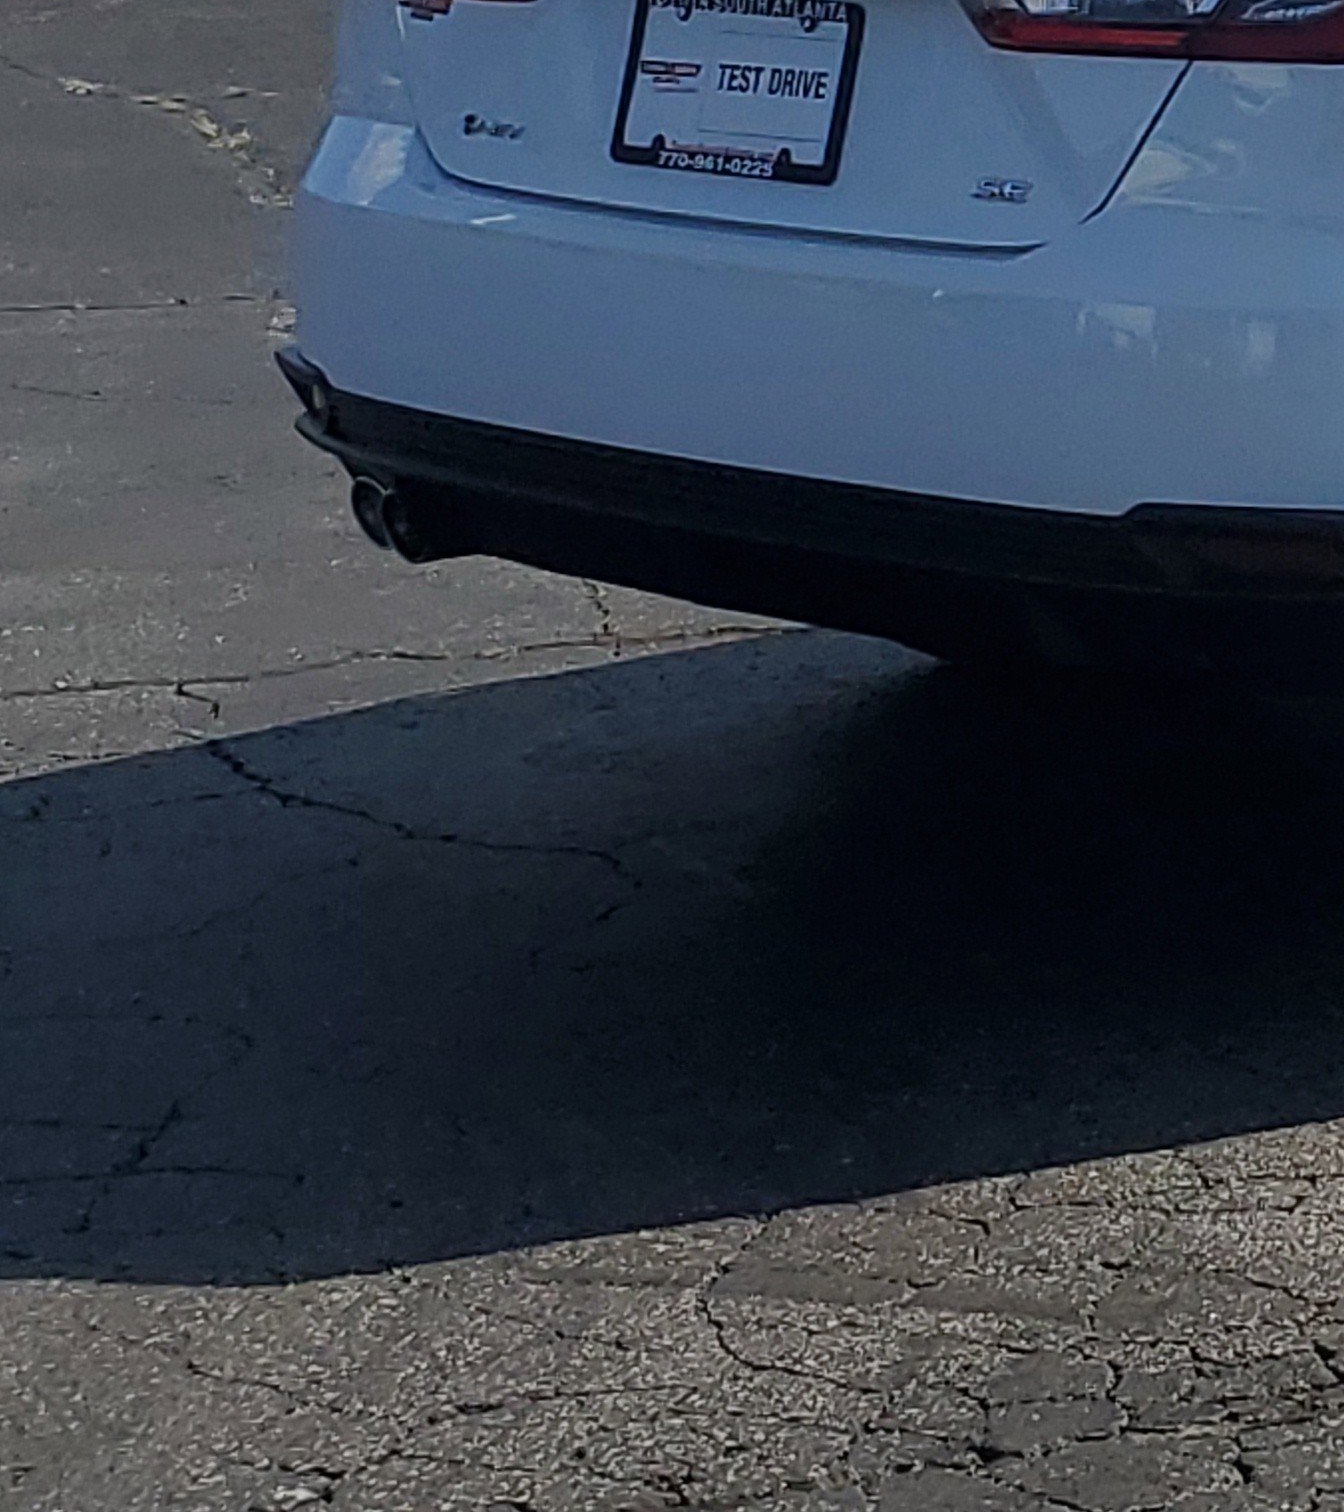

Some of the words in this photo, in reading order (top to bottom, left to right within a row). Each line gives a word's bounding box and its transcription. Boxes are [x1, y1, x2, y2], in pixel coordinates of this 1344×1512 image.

[772, 0, 848, 20] ATLANTA
[717, 63, 764, 94] TEST
[768, 68, 829, 99] DRIVE
[970, 180, 1034, 204] SE
